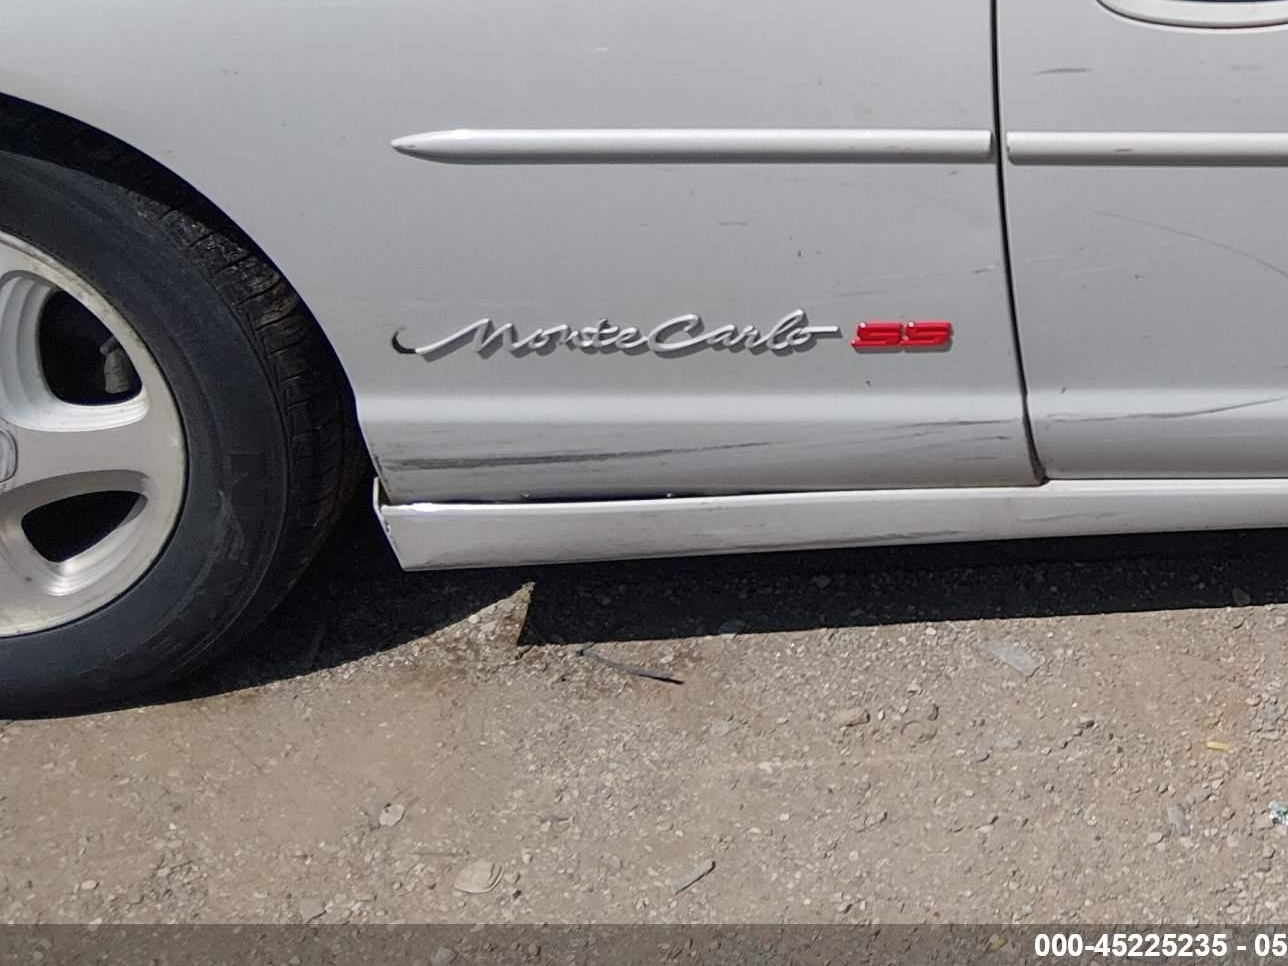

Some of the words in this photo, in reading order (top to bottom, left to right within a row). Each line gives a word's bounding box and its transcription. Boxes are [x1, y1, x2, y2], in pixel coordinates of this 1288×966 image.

[391, 318, 648, 354] Monte
[647, 309, 839, 352] Carlo
[850, 321, 951, 347] SS
